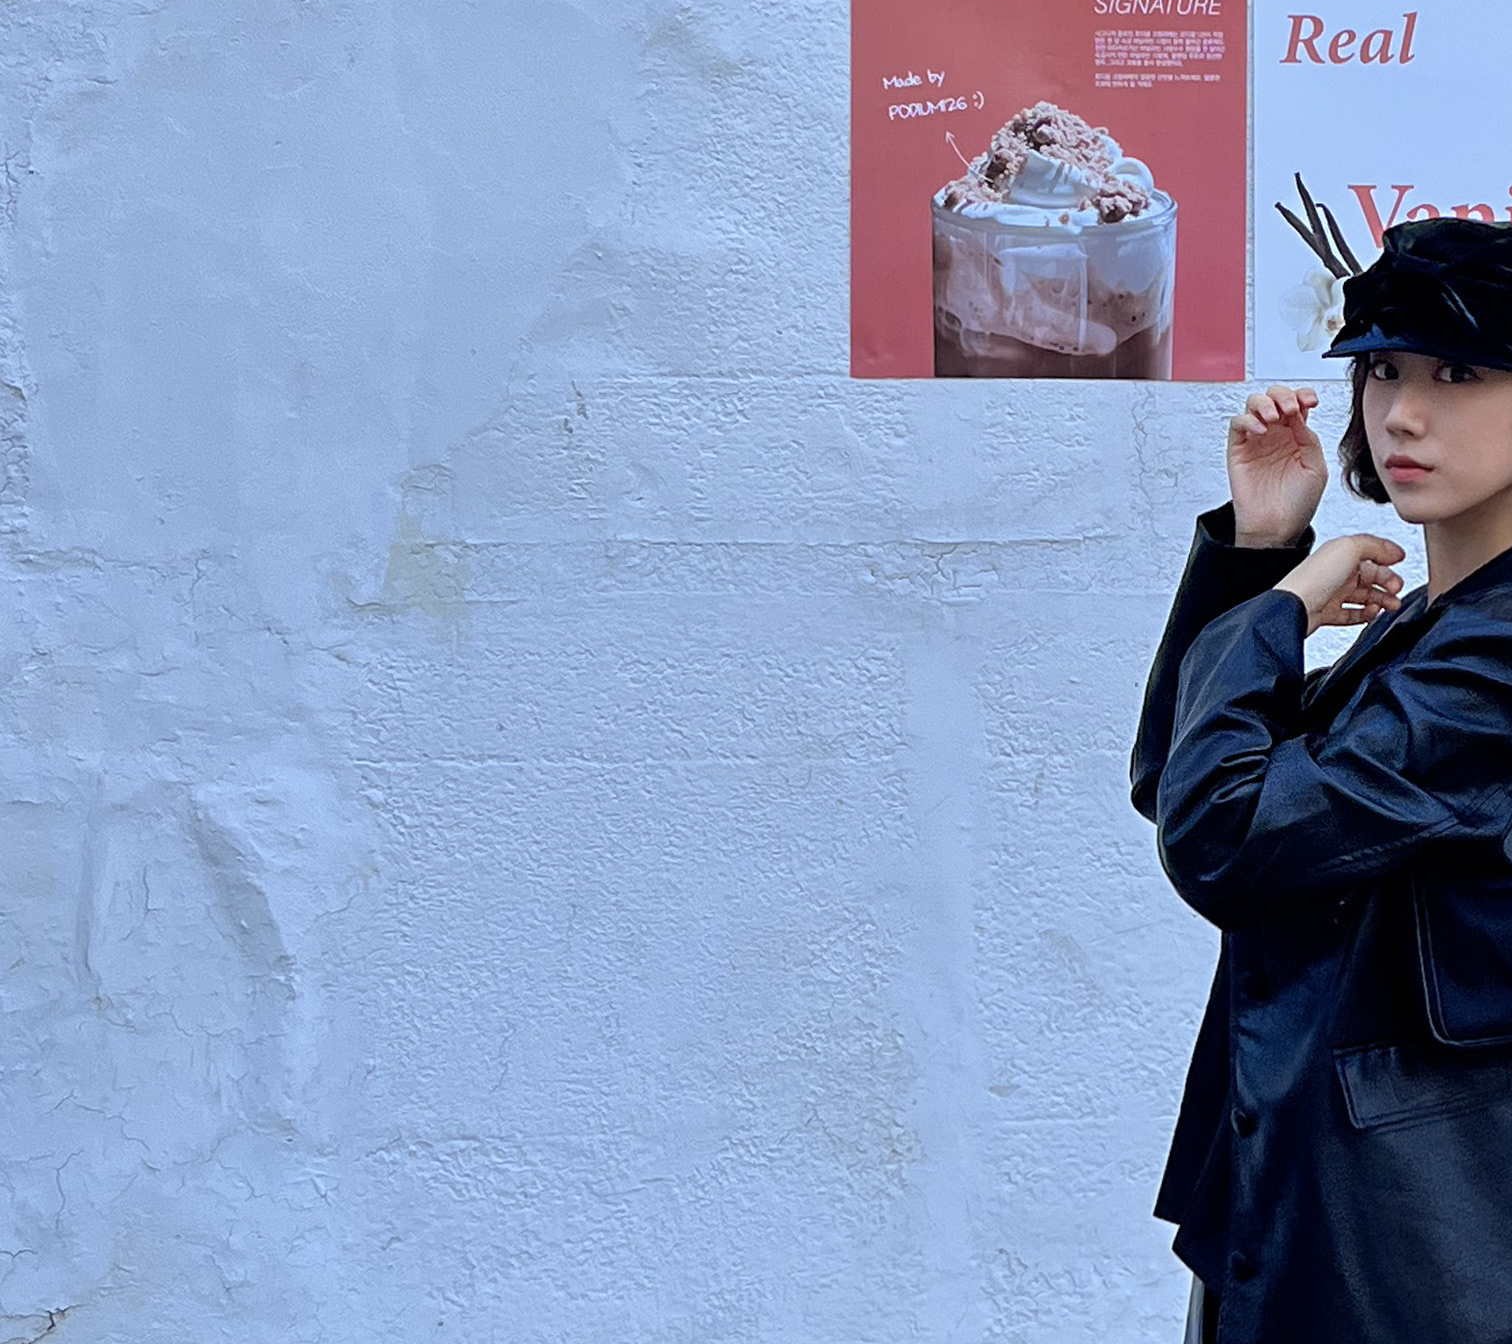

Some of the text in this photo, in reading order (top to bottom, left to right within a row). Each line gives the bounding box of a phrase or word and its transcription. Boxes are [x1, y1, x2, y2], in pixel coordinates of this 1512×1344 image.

[1280, 12, 1417, 64] Real
[883, 69, 944, 89] Made by
